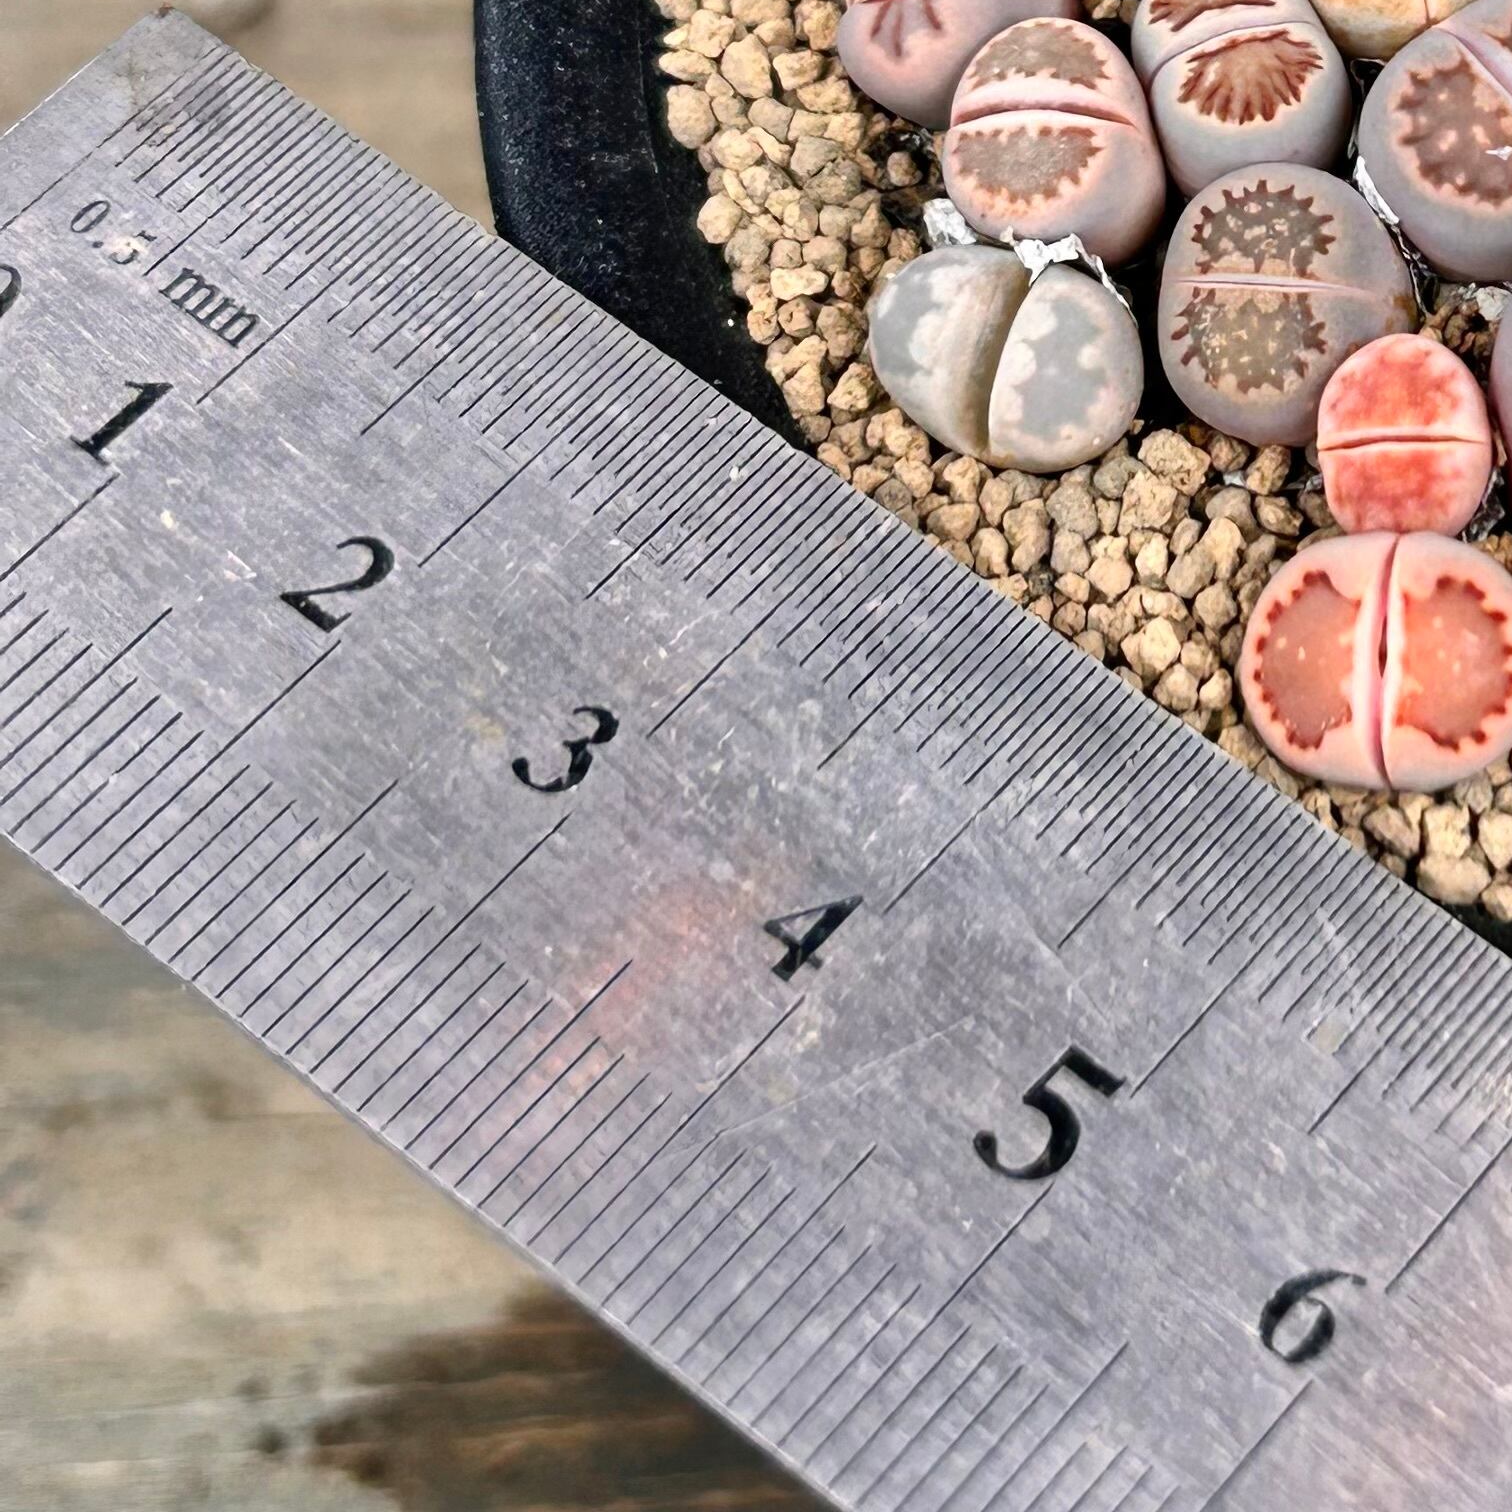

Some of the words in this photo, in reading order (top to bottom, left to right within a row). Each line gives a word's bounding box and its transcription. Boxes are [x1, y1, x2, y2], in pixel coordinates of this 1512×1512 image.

[159, 267, 260, 348] mm
[70, 380, 173, 465] 1
[280, 536, 395, 633] 2
[512, 706, 619, 793] 3
[763, 895, 863, 982] 4
[972, 1045, 1128, 1181] 5
[1258, 1268, 1367, 1365] 6
